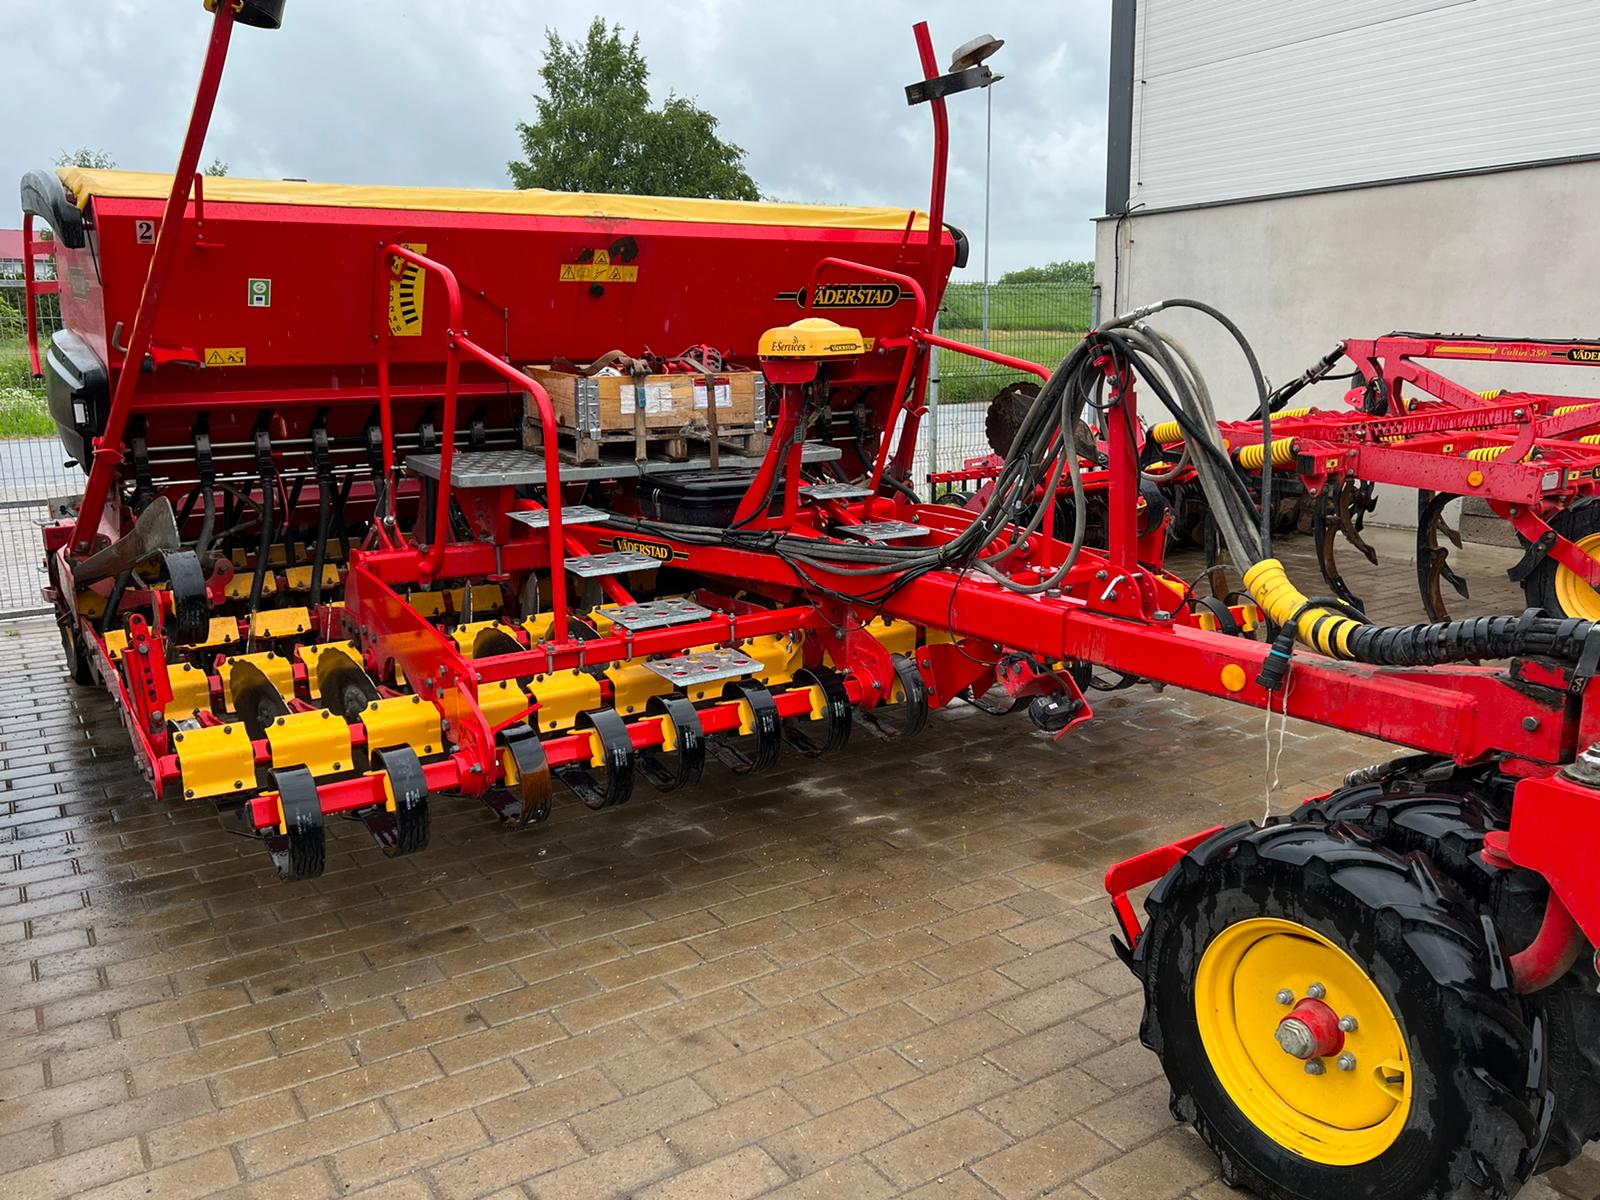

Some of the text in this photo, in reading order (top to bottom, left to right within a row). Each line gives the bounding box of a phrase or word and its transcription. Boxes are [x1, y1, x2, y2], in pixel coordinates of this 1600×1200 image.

[138, 222, 153, 240] 2
[812, 286, 894, 305] ÄDERSTAD
[392, 325, 402, 333] 16
[1530, 349, 1547, 358] 350
[617, 539, 668, 558] VÄDERSTAD
